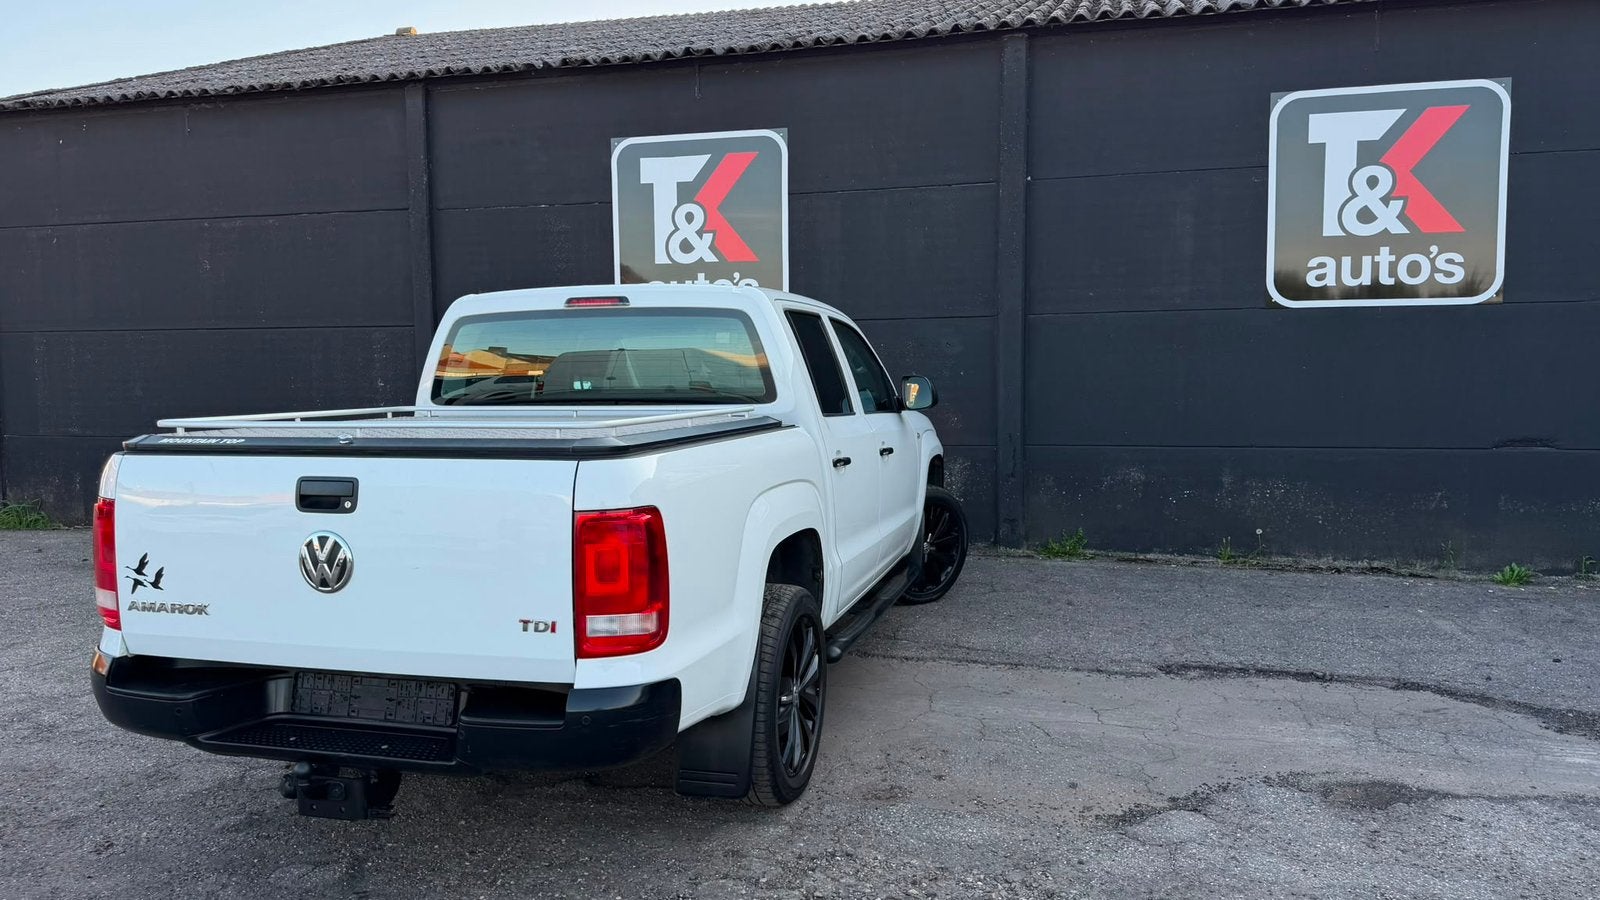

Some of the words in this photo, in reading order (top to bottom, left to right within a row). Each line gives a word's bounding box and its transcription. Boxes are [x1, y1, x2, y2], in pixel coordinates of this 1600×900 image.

[1308, 104, 1471, 236] T&K
[639, 151, 760, 264] T&K
[1305, 245, 1465, 288] auto's
[220, 437, 246, 445] TOP
[127, 600, 210, 616] AMAROK
[518, 619, 557, 634] TDI
